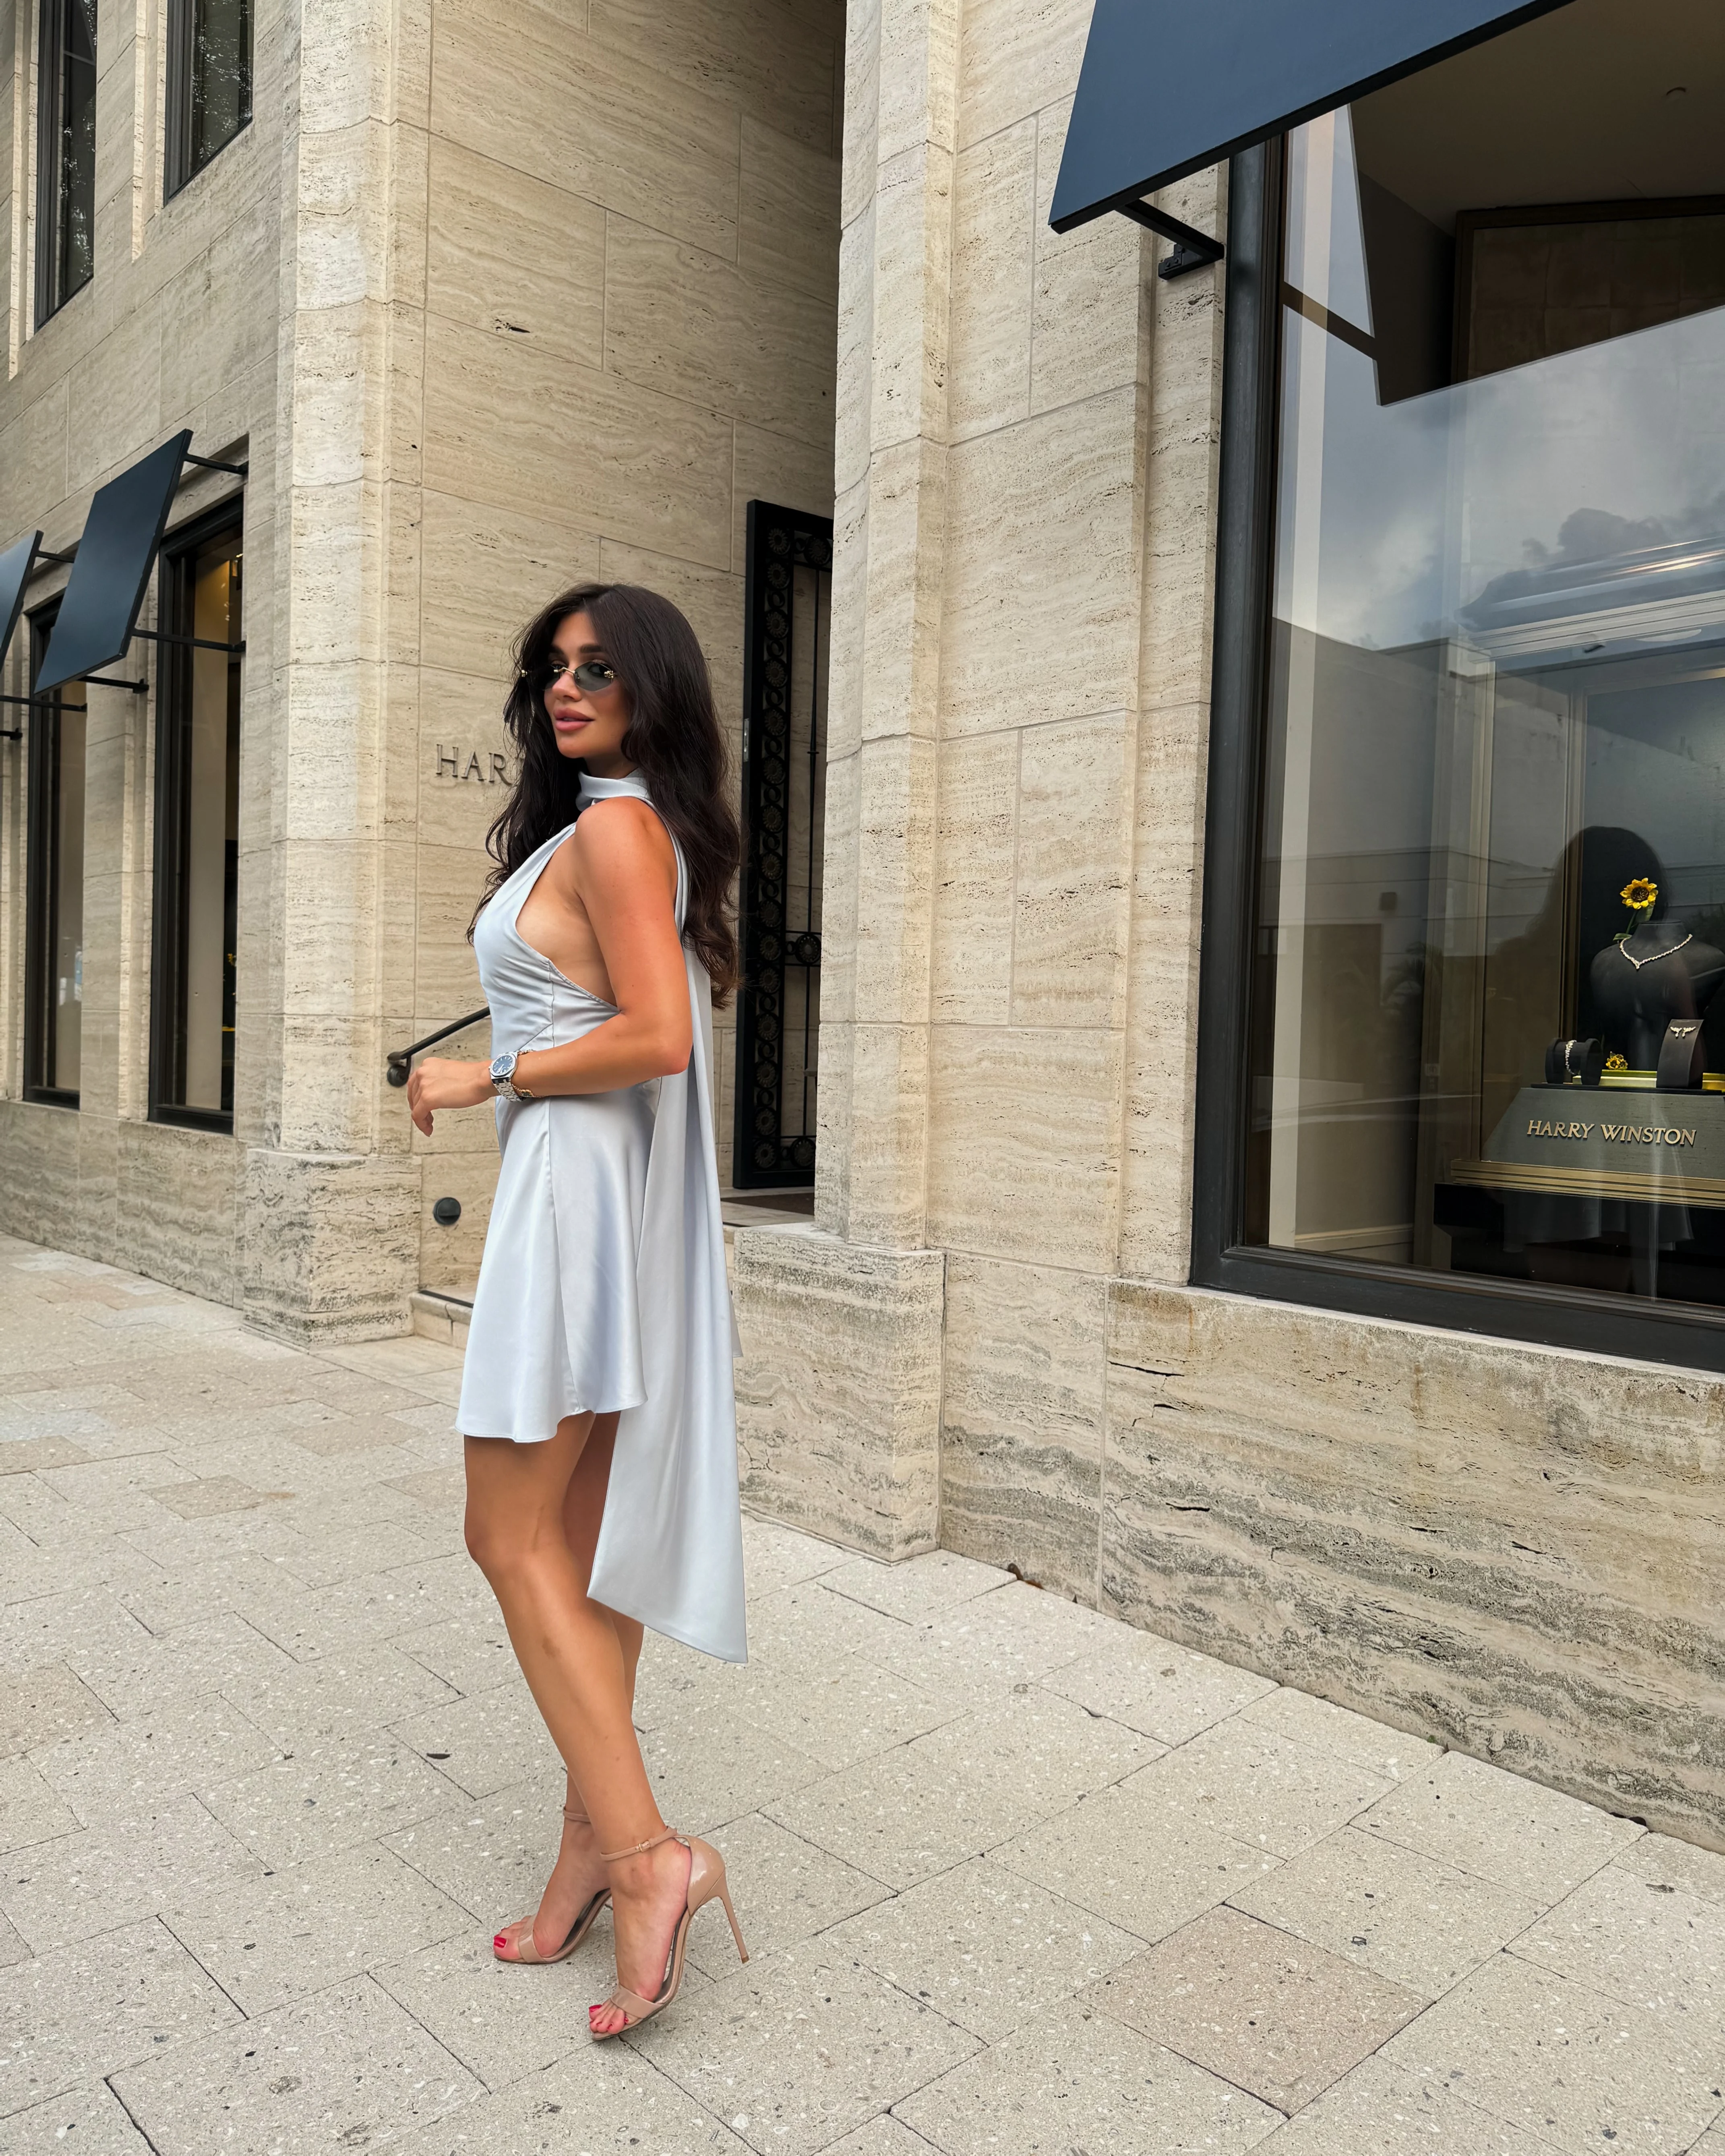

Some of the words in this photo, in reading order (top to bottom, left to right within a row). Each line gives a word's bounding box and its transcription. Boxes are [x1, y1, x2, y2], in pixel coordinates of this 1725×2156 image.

[436, 744, 523, 786] HAR
[1527, 1120, 1595, 1139] HARRY
[1601, 1124, 1696, 1146] WINSTON
